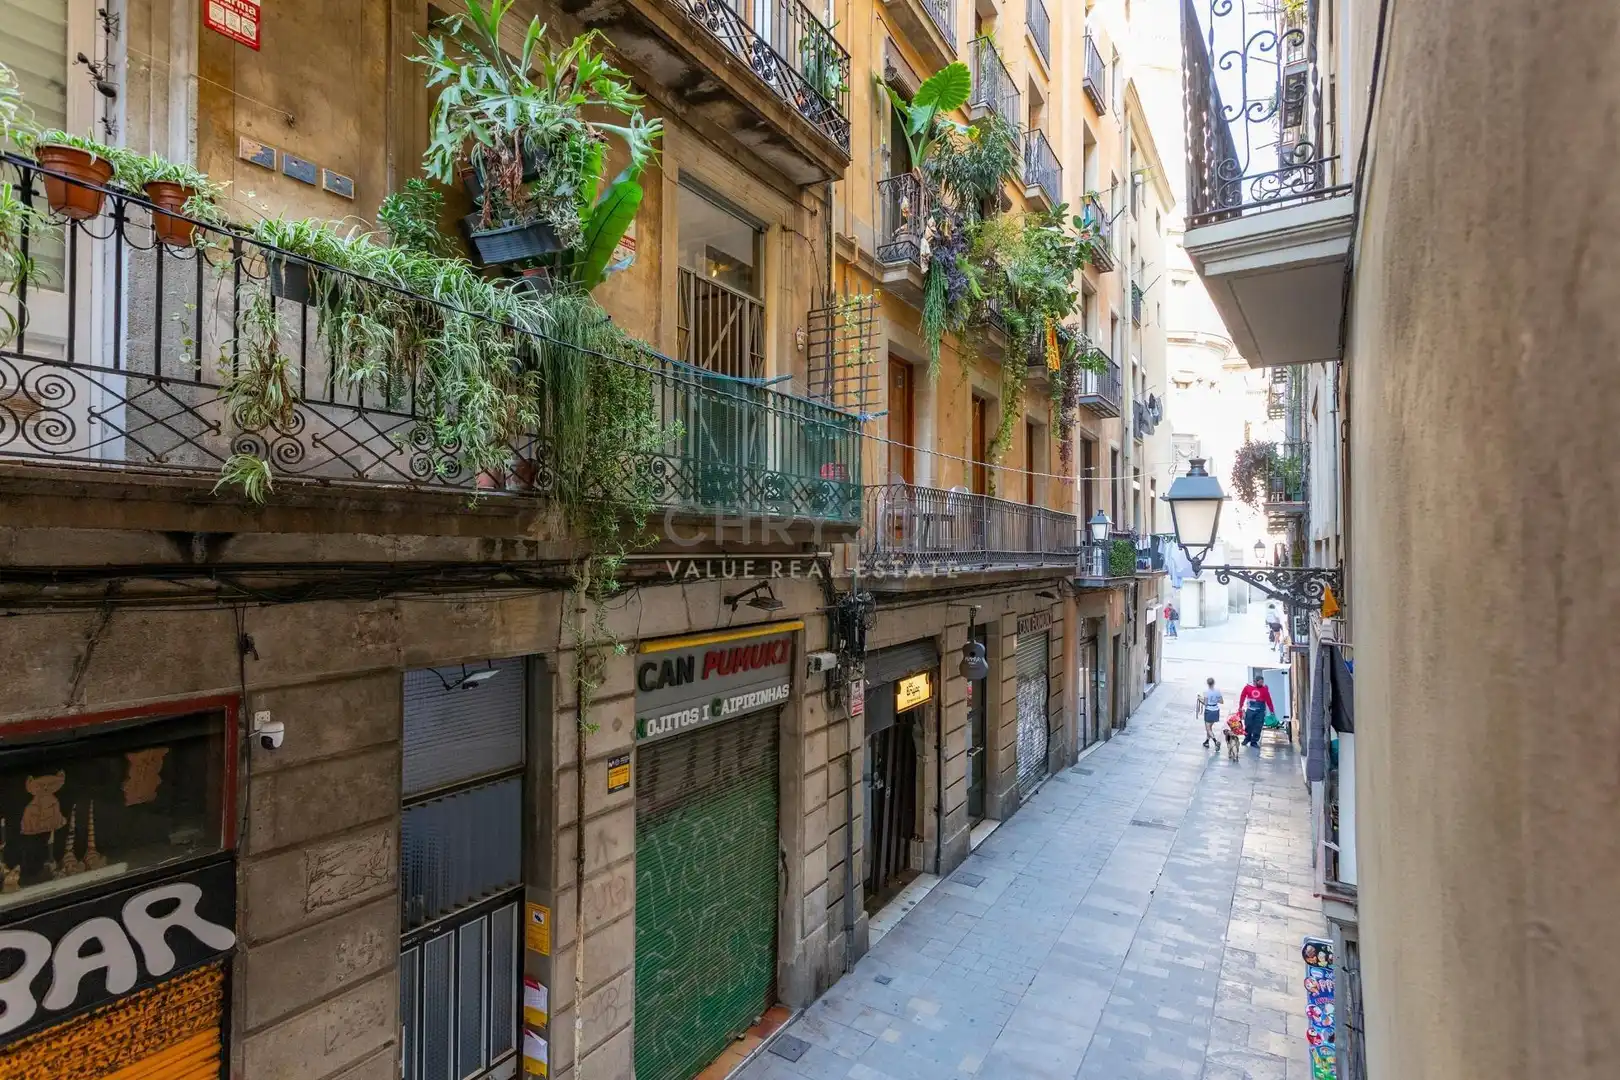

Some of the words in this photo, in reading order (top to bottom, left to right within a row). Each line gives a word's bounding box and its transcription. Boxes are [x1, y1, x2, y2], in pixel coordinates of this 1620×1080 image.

[638, 655, 695, 693] CAN
[702, 638, 792, 681] PUMUKI
[635, 706, 700, 741] MOJITOS
[702, 704, 710, 721] I
[711, 683, 791, 717] CAIPIRINHAS
[0, 882, 236, 1035] BAR
